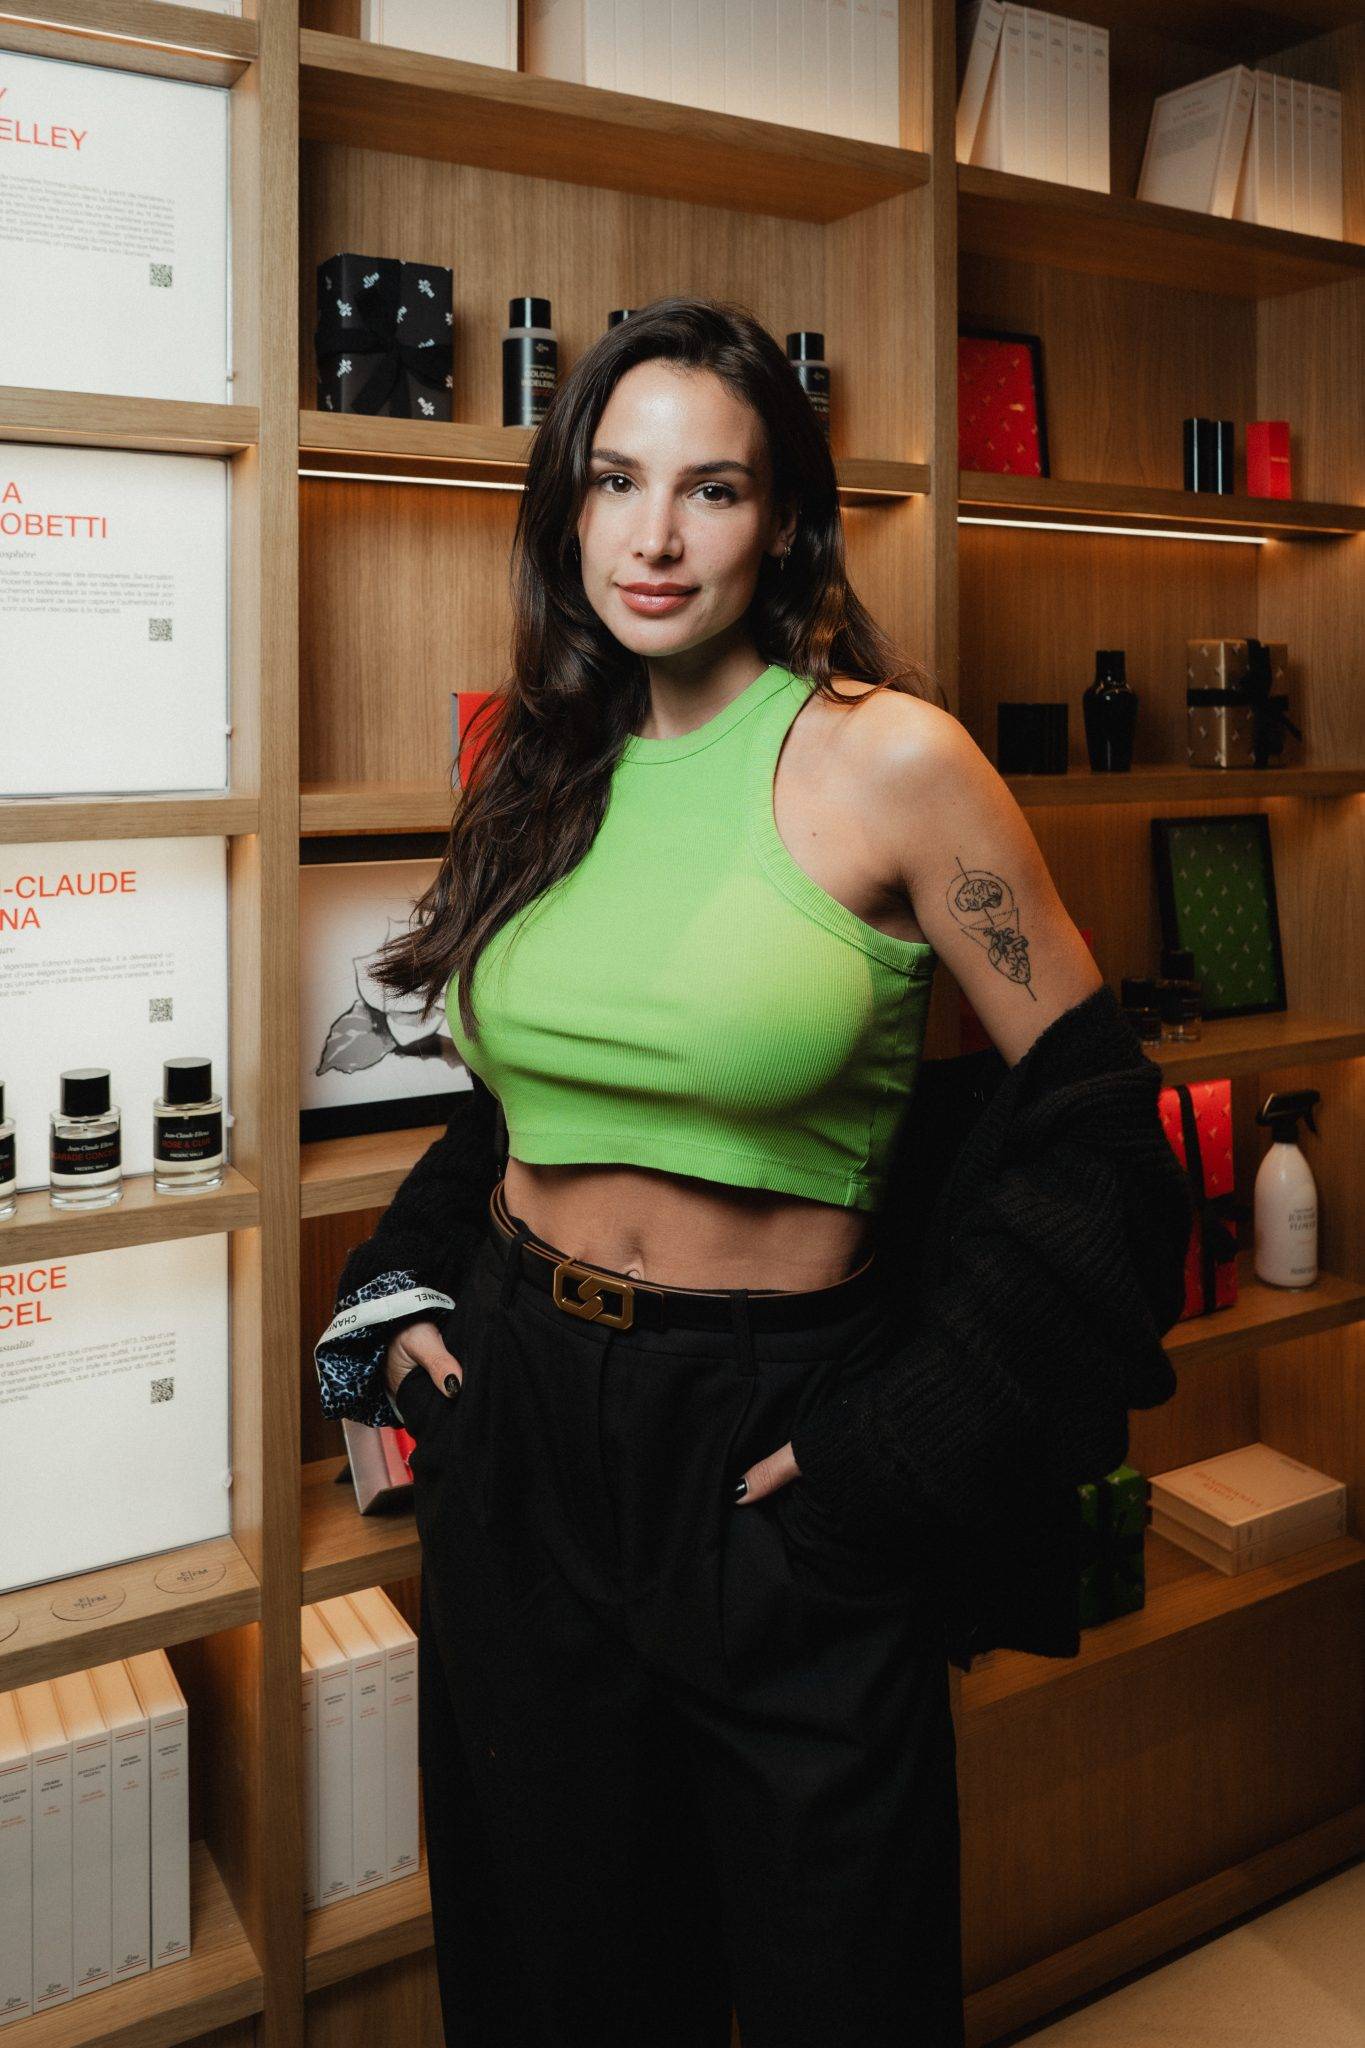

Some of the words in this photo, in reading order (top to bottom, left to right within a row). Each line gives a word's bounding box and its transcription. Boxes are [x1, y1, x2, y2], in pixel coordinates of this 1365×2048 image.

[0, 118, 88, 151] ELLEY
[2, 482, 22, 504] A
[0, 512, 107, 539] OBETTI
[4, 871, 136, 899] -CLAUDE
[0, 907, 41, 931] NA
[0, 1266, 67, 1298] RICE
[0, 1301, 52, 1329] CEL
